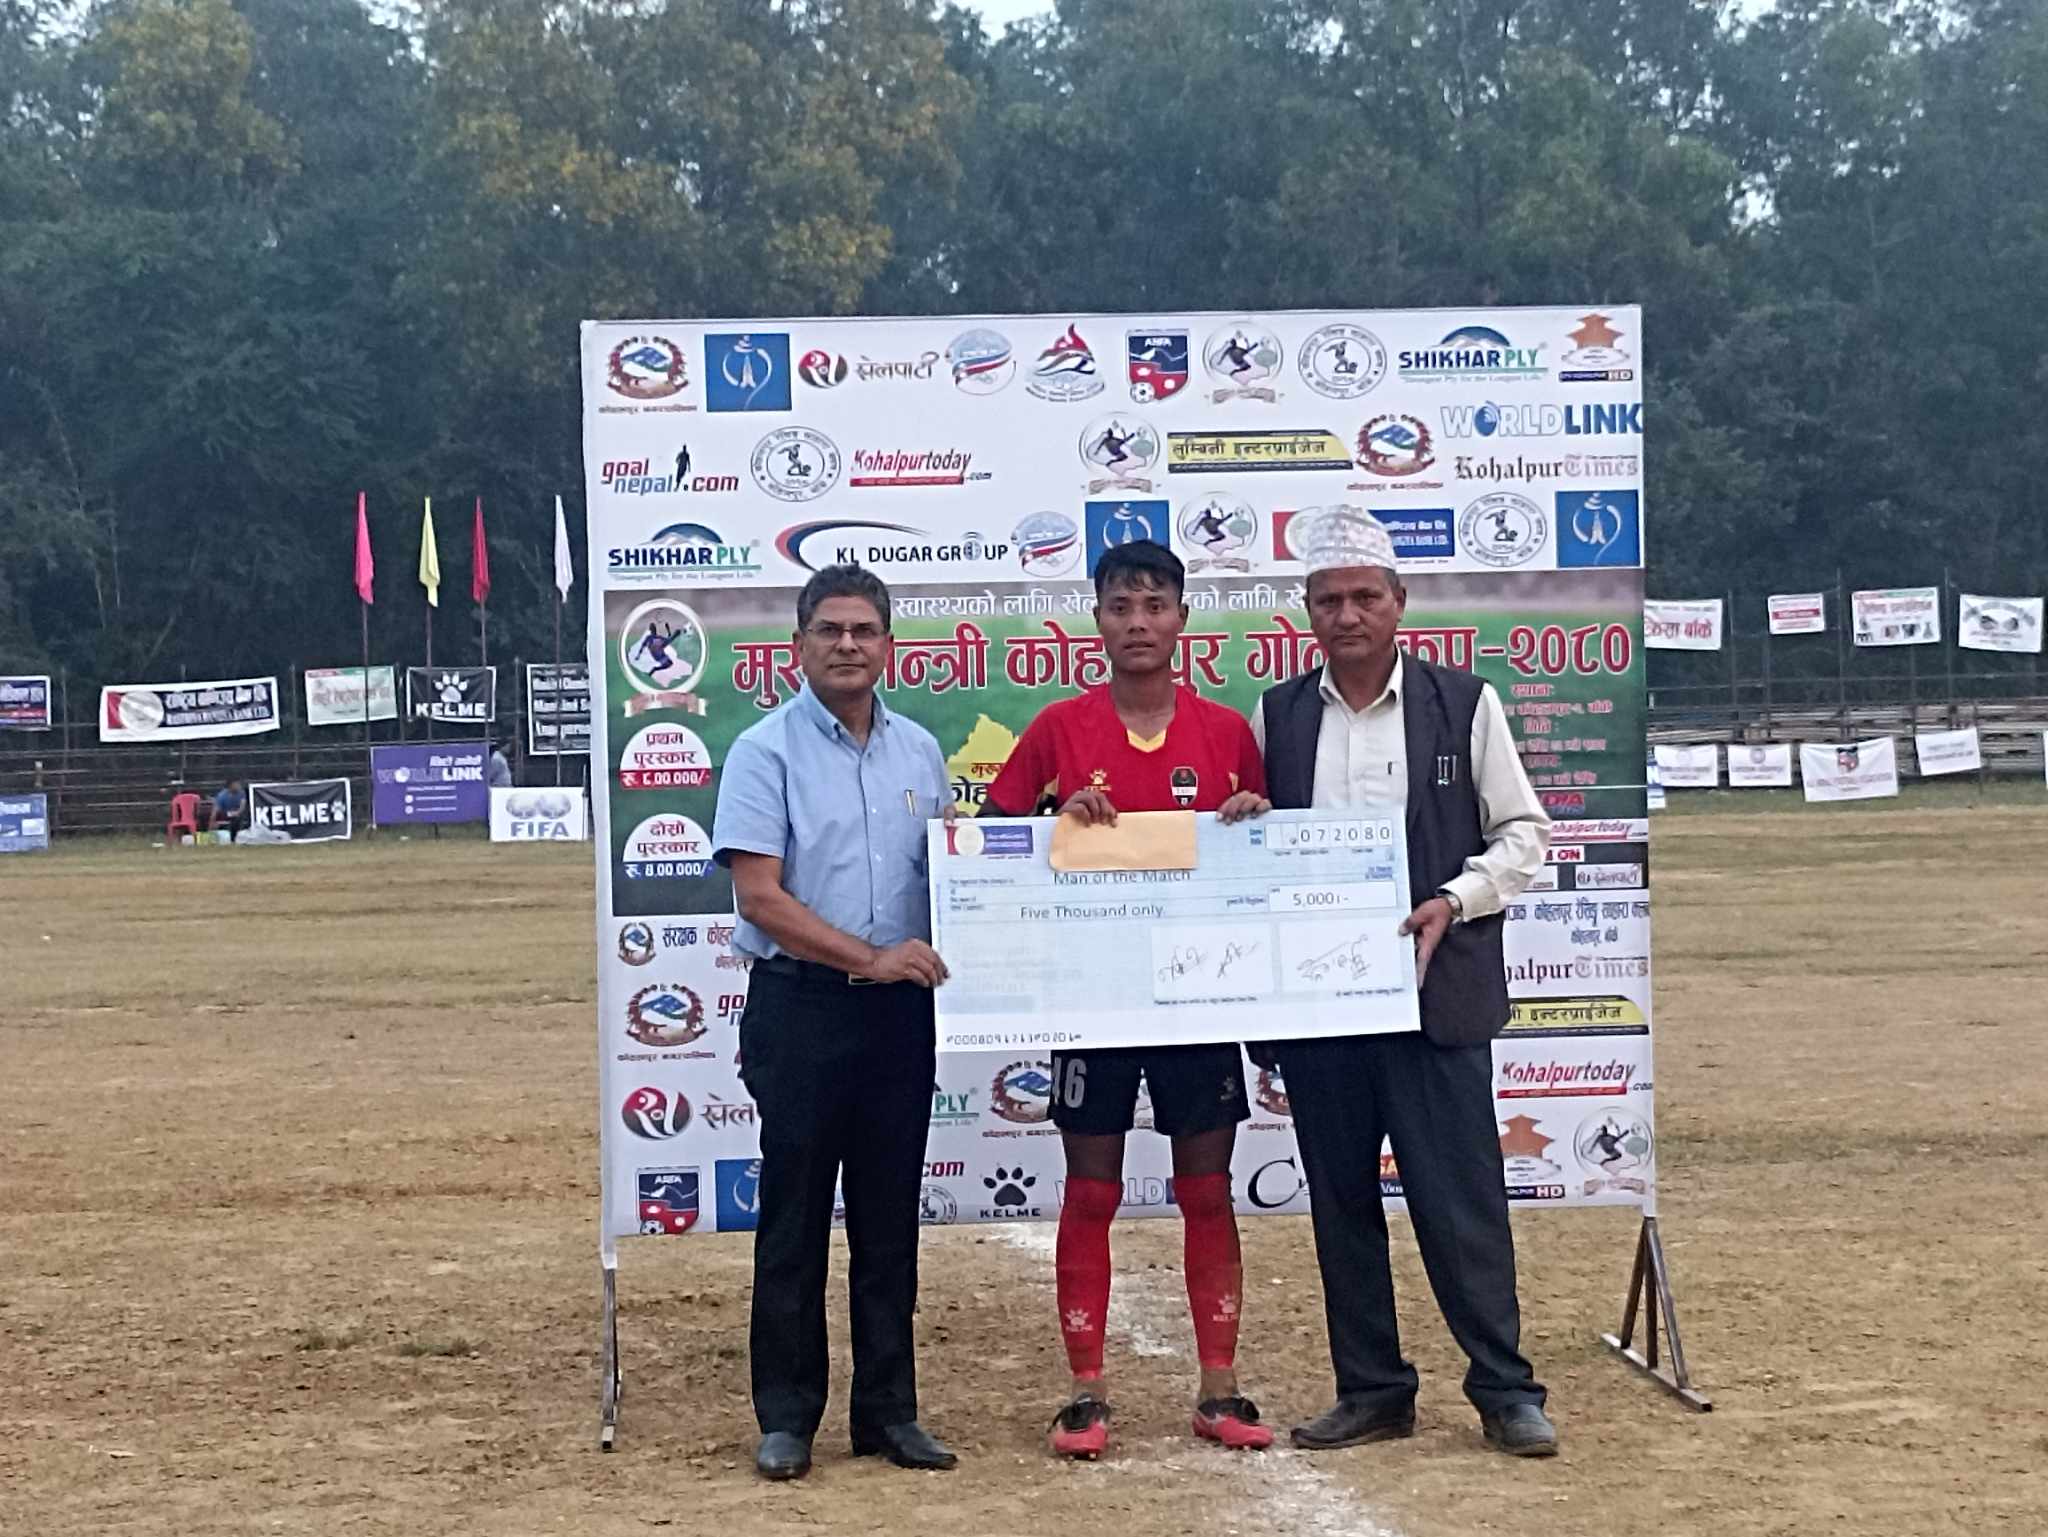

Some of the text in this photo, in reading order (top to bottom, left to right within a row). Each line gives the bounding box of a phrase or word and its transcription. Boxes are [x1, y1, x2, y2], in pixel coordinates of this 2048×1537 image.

[1440, 402, 1644, 438] WORLDLINK
[602, 459, 650, 484] goal
[836, 540, 1009, 564] KL DUGAR GROUP
[1003, 588, 1054, 615] लागि
[1229, 583, 1277, 610] लागि
[416, 702, 486, 717] KELME
[256, 802, 330, 826] KELME
[511, 821, 569, 837] FIFA
[1054, 869, 1190, 885] Man of the Match
[1020, 906, 1050, 920] Five
[1054, 904, 1127, 919] Thousand
[1502, 1059, 1636, 1090] Kohalpurtoday
[1536, 1187, 1565, 1198] HD
[980, 1208, 1041, 1219] KELME
